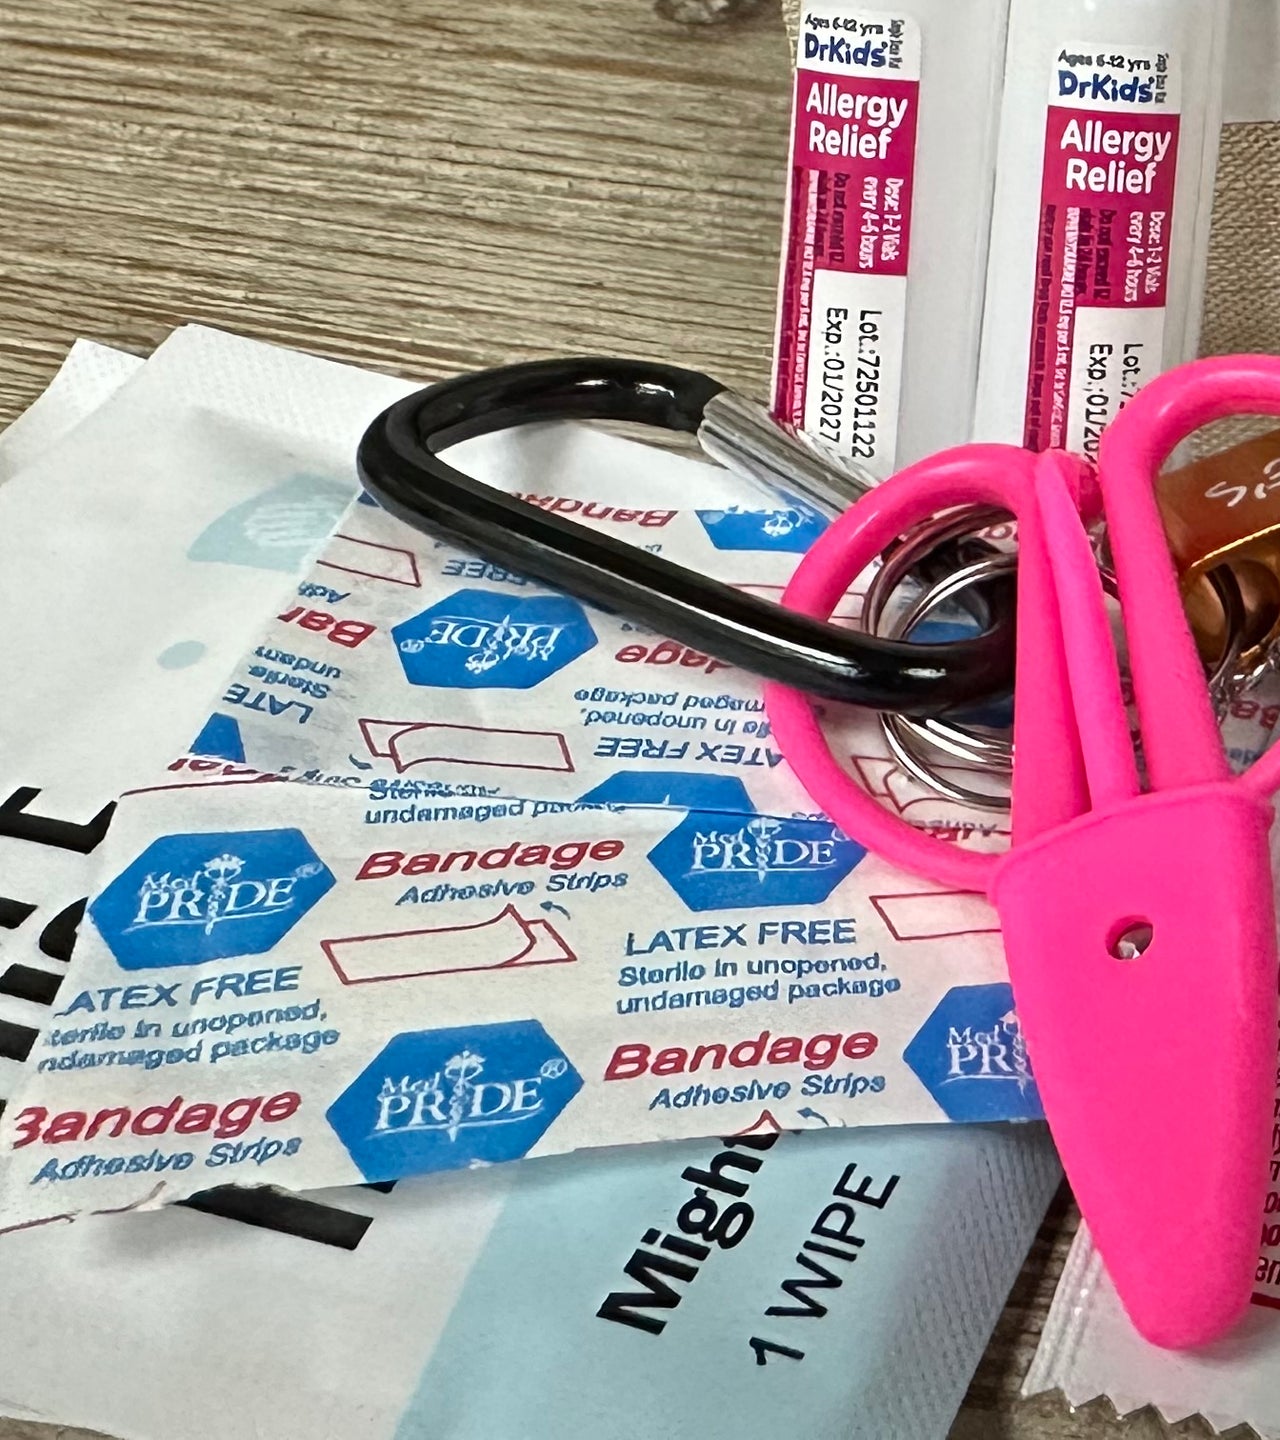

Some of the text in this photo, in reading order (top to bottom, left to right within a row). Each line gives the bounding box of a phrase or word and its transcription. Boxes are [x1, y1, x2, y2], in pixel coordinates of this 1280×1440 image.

[806, 82, 908, 129] Allergy
[809, 120, 892, 159] Relief
[1060, 119, 1172, 163] Allergy
[1066, 158, 1157, 195] Relief
[594, 736, 690, 760] FREE
[354, 839, 626, 881] Bandage
[395, 872, 629, 906] Adhesive Strips
[625, 918, 856, 956] LATEX FREE
[190, 965, 303, 1005] FREE
[788, 977, 901, 1004] package
[603, 1030, 879, 1082] Bandage
[649, 1072, 886, 1111] Adhesive Strips
[749, 1162, 901, 1366] 1 WIPE
